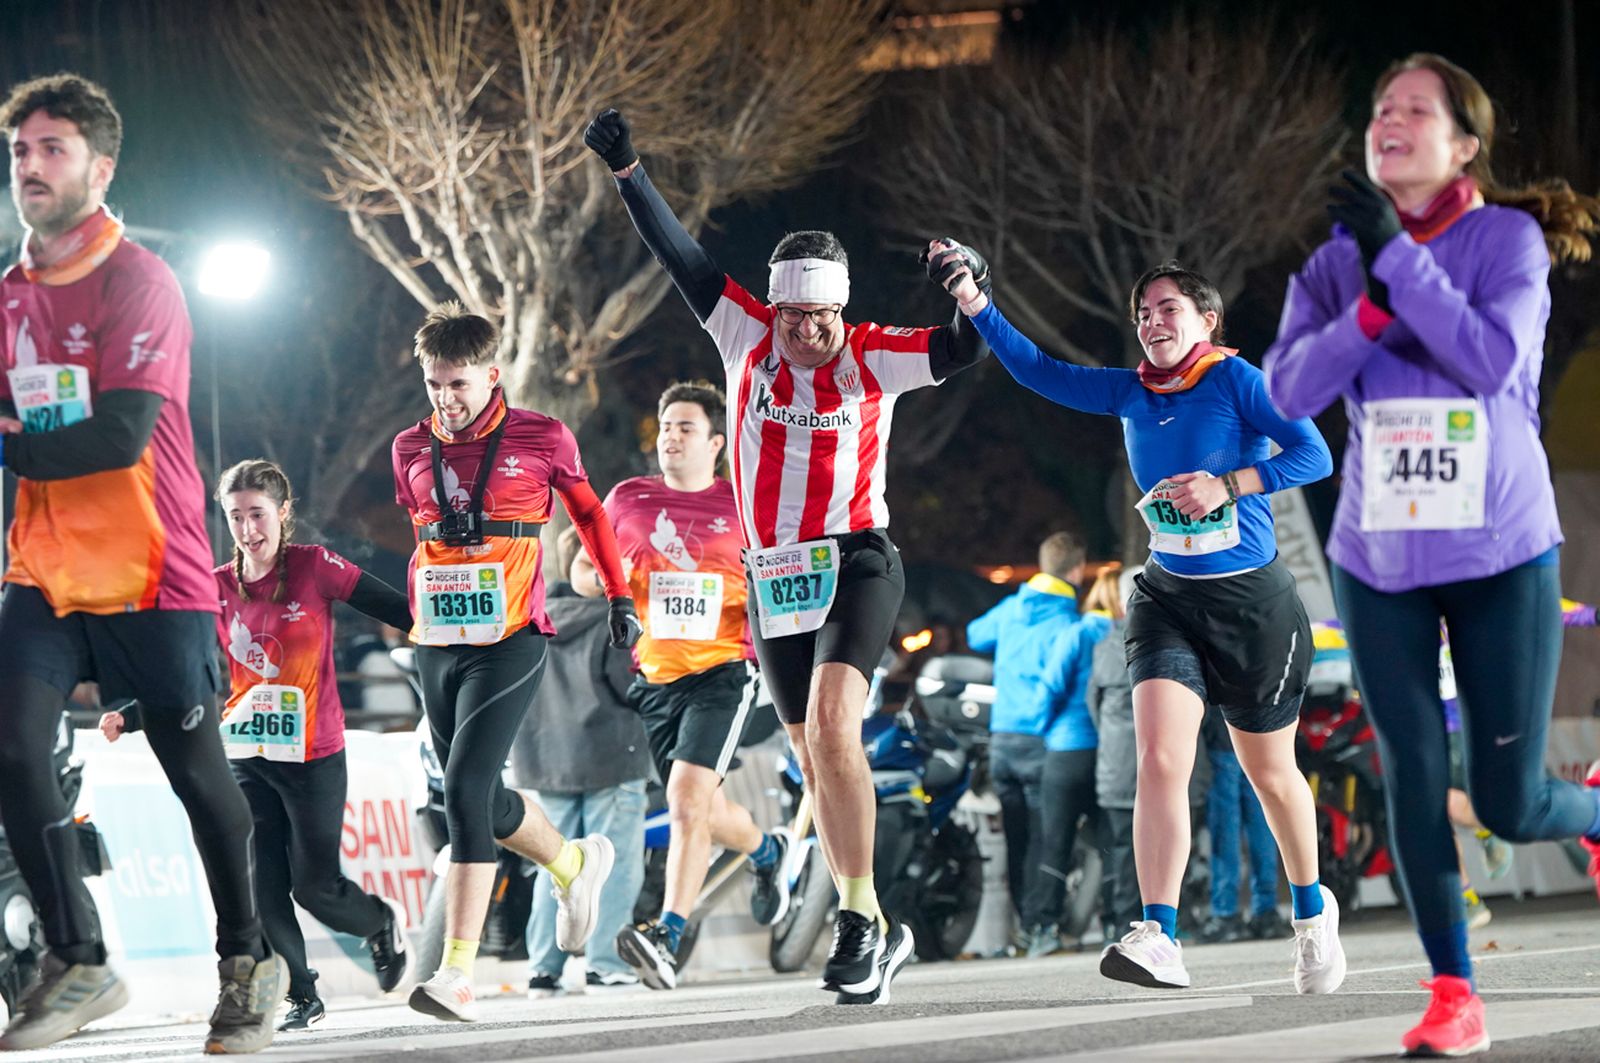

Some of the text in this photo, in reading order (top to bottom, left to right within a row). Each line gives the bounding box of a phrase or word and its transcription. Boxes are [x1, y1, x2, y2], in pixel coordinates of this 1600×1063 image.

[664, 542, 683, 560] 43
[766, 556, 790, 566] NOCHE
[791, 553, 802, 562] DE
[435, 573, 459, 582] NOCHE
[460, 572, 471, 581] DE
[761, 569, 775, 579] SAN
[426, 584, 442, 592] SAN
[770, 573, 822, 606] 8237
[430, 592, 494, 617] 13316
[663, 596, 706, 616] 1384
[246, 649, 265, 670] 43
[230, 713, 295, 737] 12966
[340, 799, 410, 859] SAN
[114, 847, 191, 897] alsa
